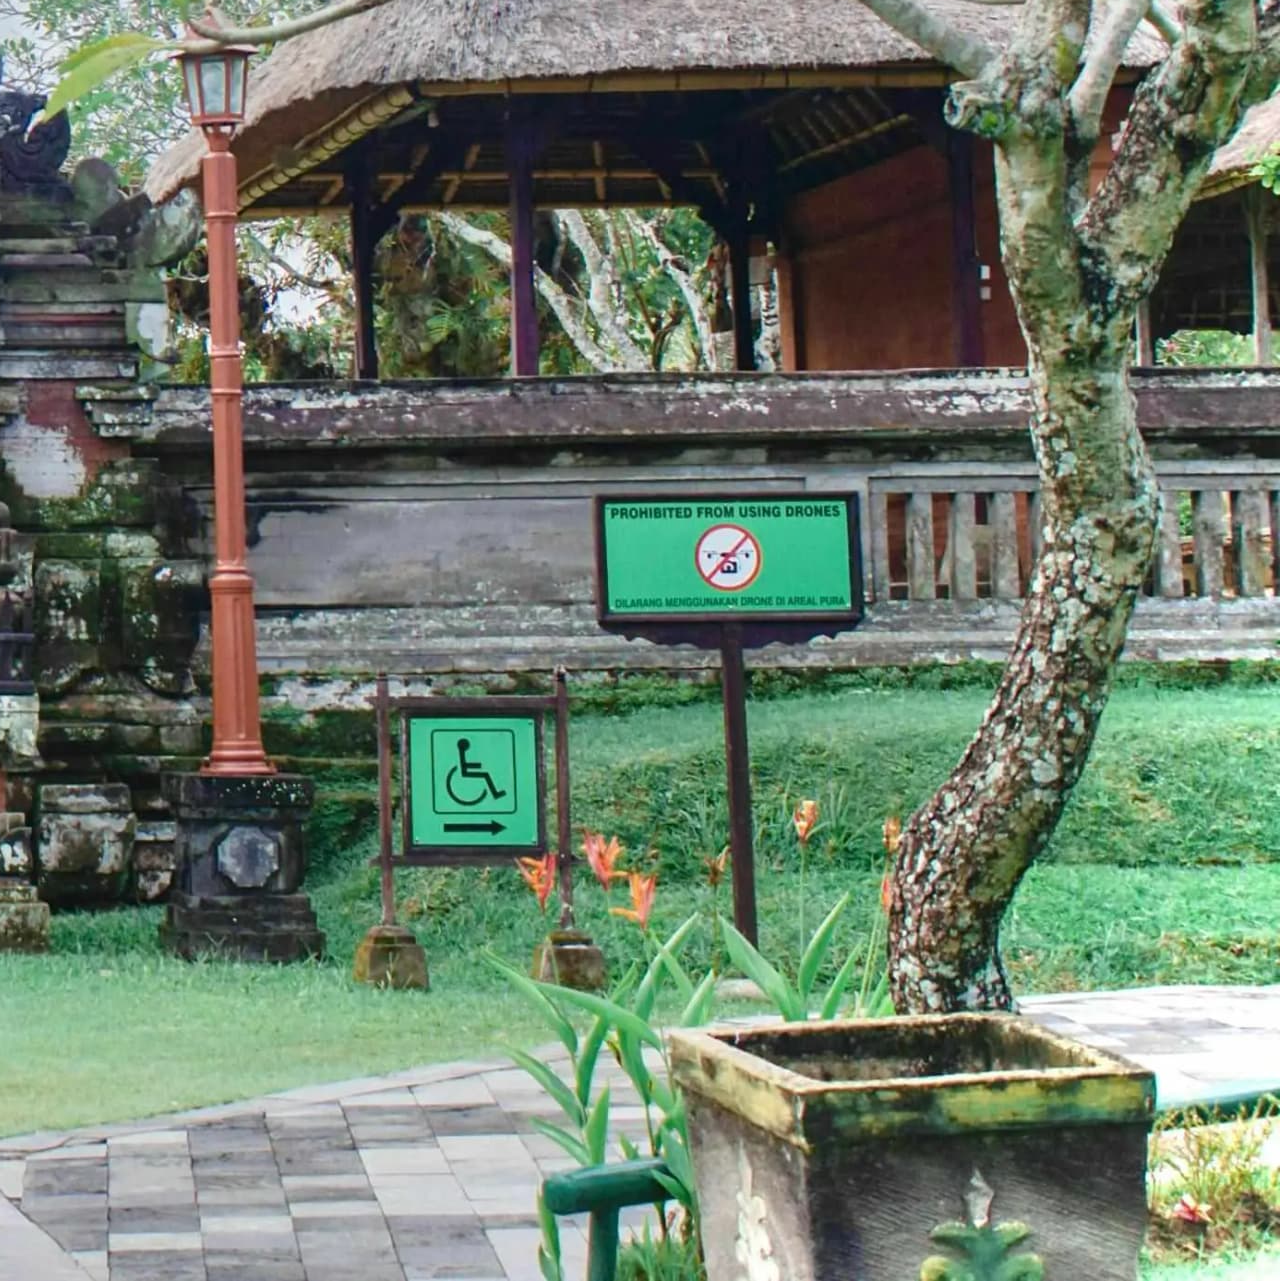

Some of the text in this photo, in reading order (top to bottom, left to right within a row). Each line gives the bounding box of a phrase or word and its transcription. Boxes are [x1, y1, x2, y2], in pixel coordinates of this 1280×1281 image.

[611, 505, 840, 519] PROHIBITED FROM USING DRONES
[615, 596, 845, 608] DILARANG MENGGUNAKAN DRONE DI AREAL PURA
